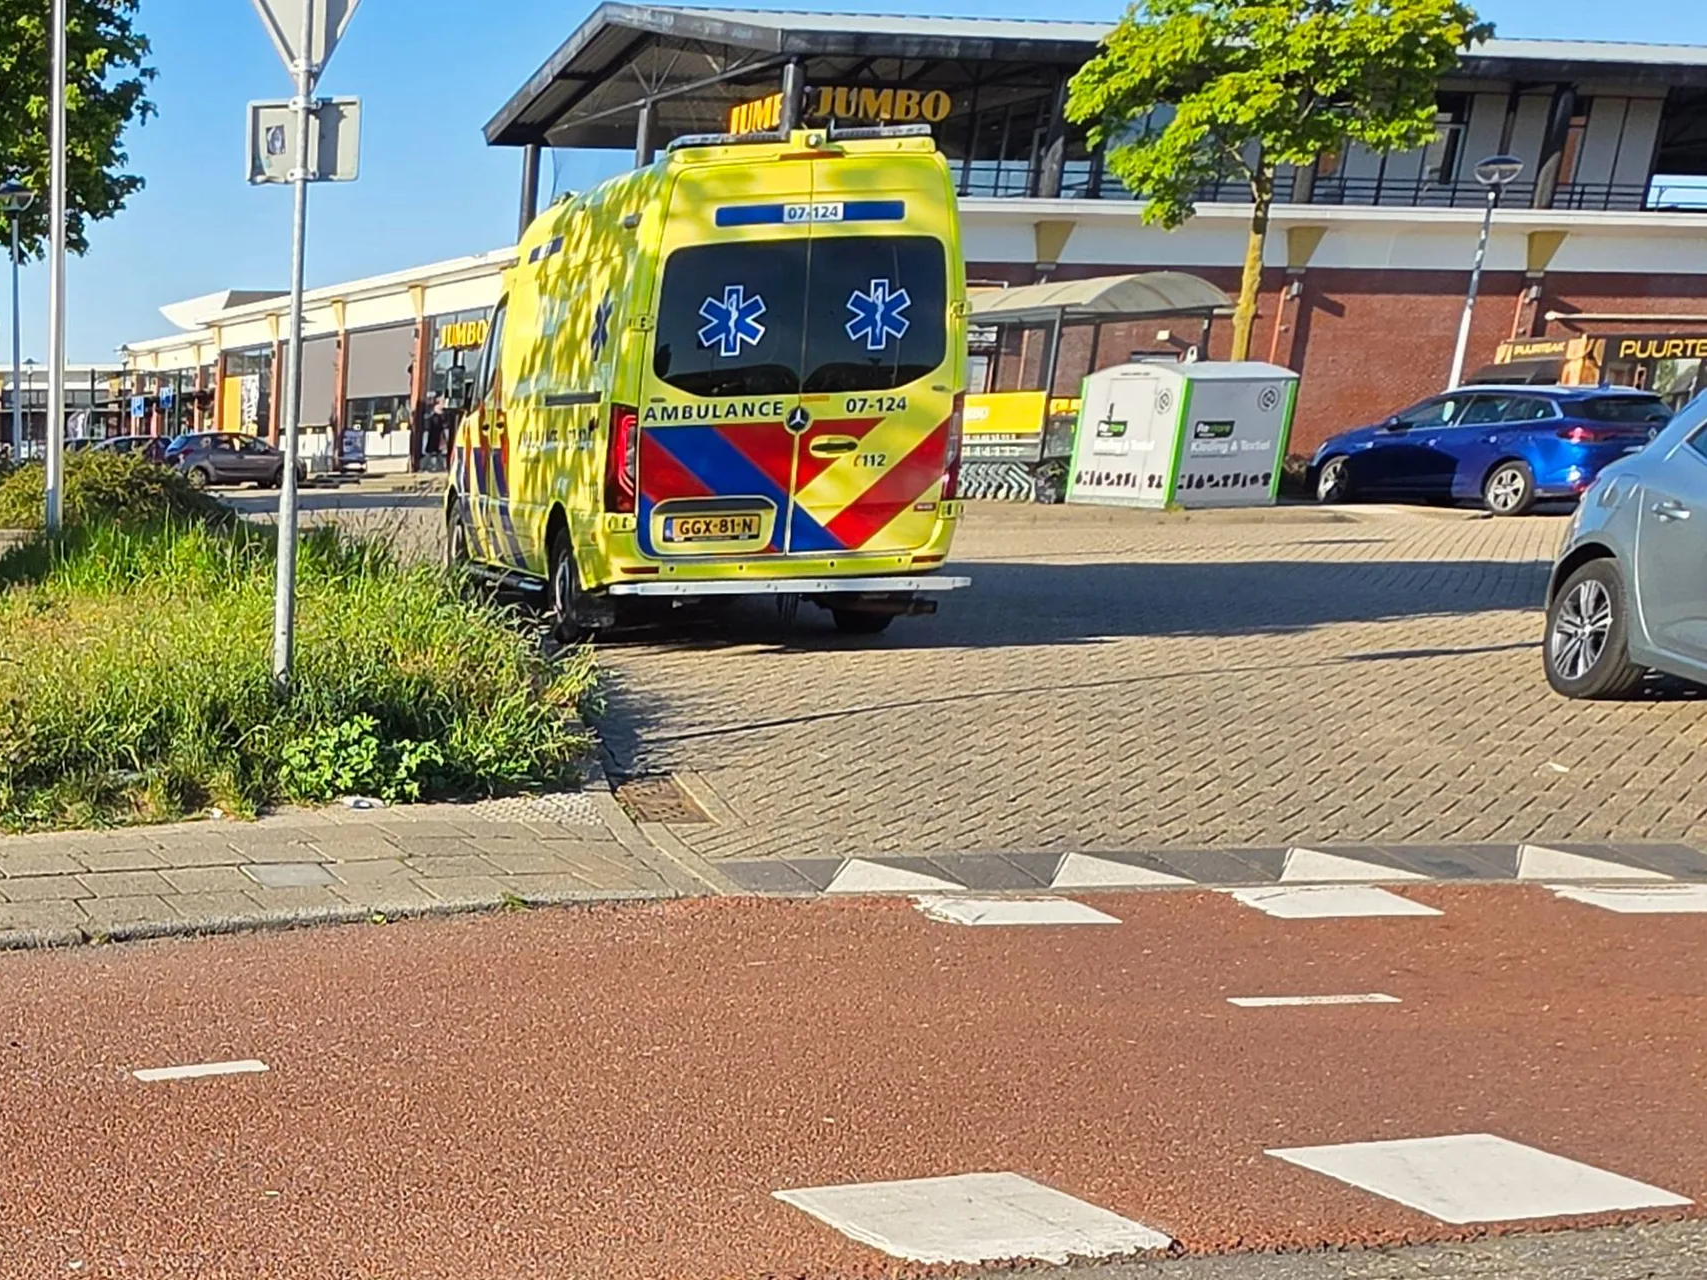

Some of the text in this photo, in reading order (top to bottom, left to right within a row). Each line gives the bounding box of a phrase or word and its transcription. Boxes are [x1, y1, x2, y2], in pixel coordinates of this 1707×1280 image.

[811, 86, 951, 122] JUMBO
[730, 92, 784, 136] JUMB
[788, 205, 838, 220] 07-124
[439, 319, 488, 348] JUMBO
[644, 401, 784, 421] AMBULANCE
[846, 397, 907, 413] 07-124
[863, 454, 886, 467] 112
[679, 518, 753, 535] GGX-81-N
